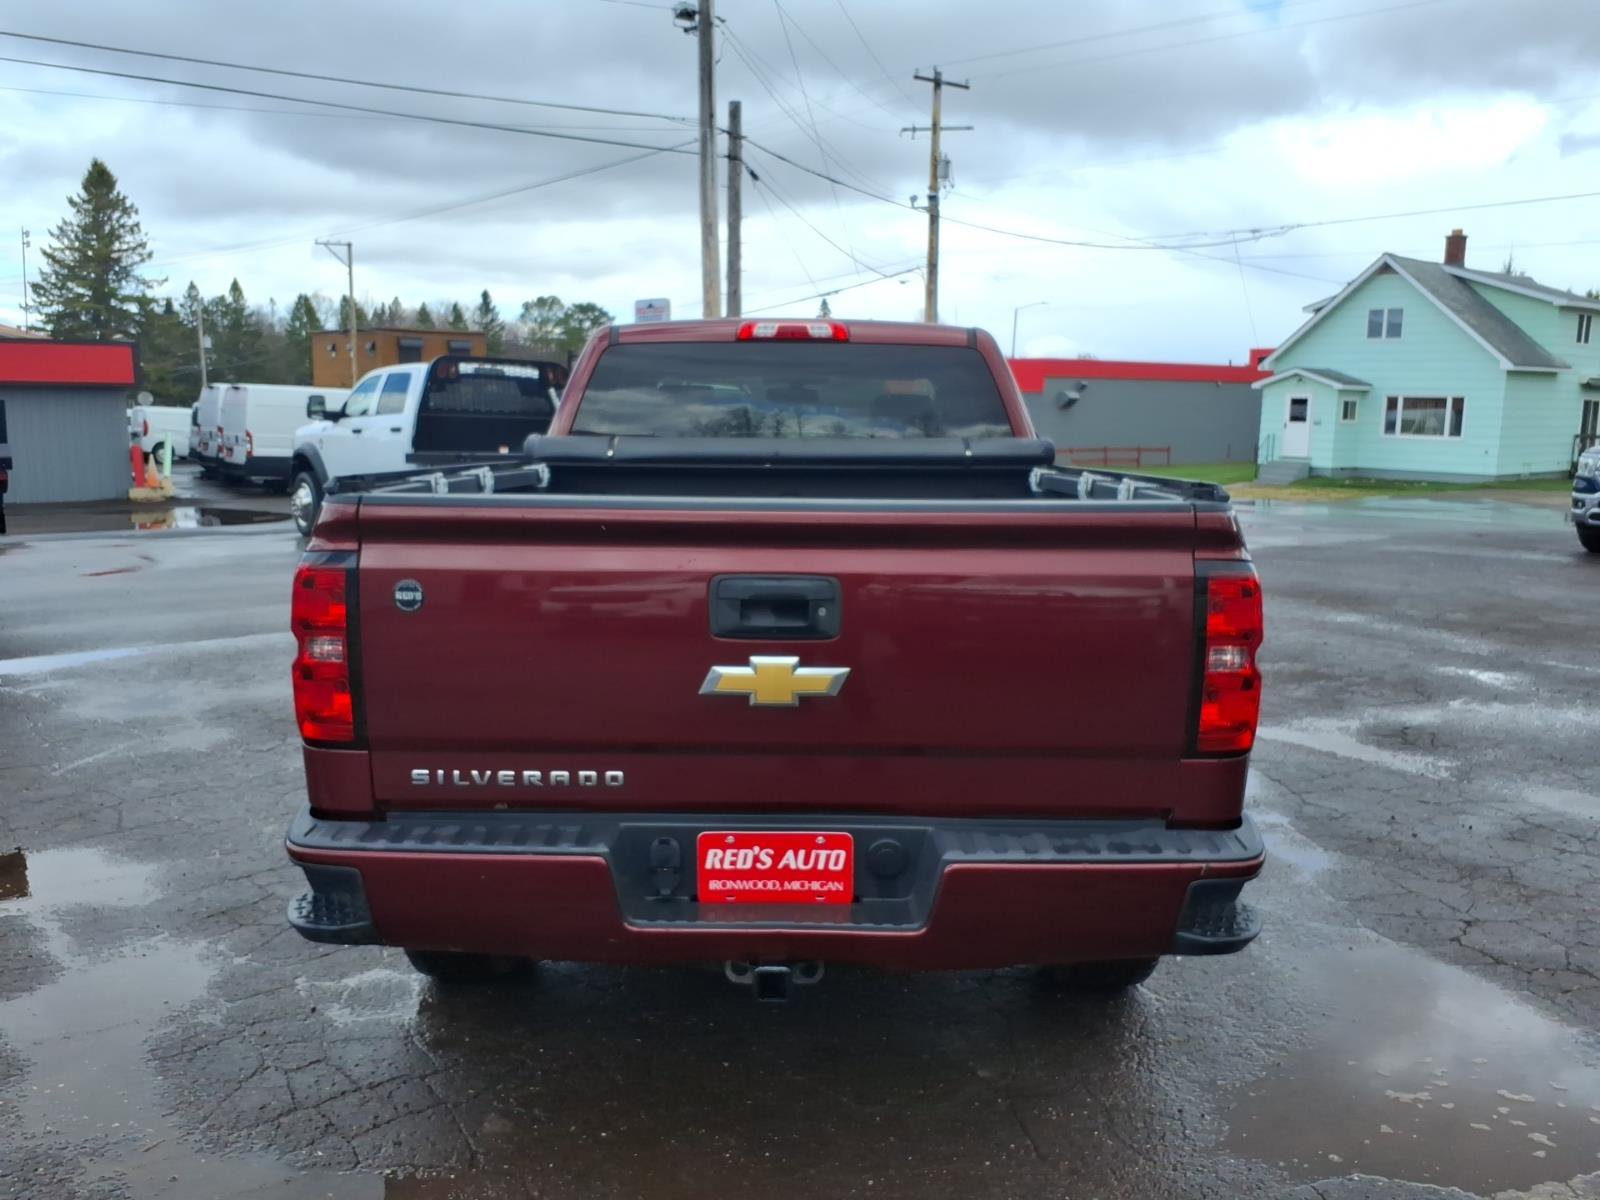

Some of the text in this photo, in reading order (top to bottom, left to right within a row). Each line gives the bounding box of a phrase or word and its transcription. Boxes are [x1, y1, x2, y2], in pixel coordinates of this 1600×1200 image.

[410, 768, 625, 787] SILVERADO
[704, 846, 847, 871] RED'S AUTO
[708, 879, 844, 892] IRONWOOD, MICHIGAN
